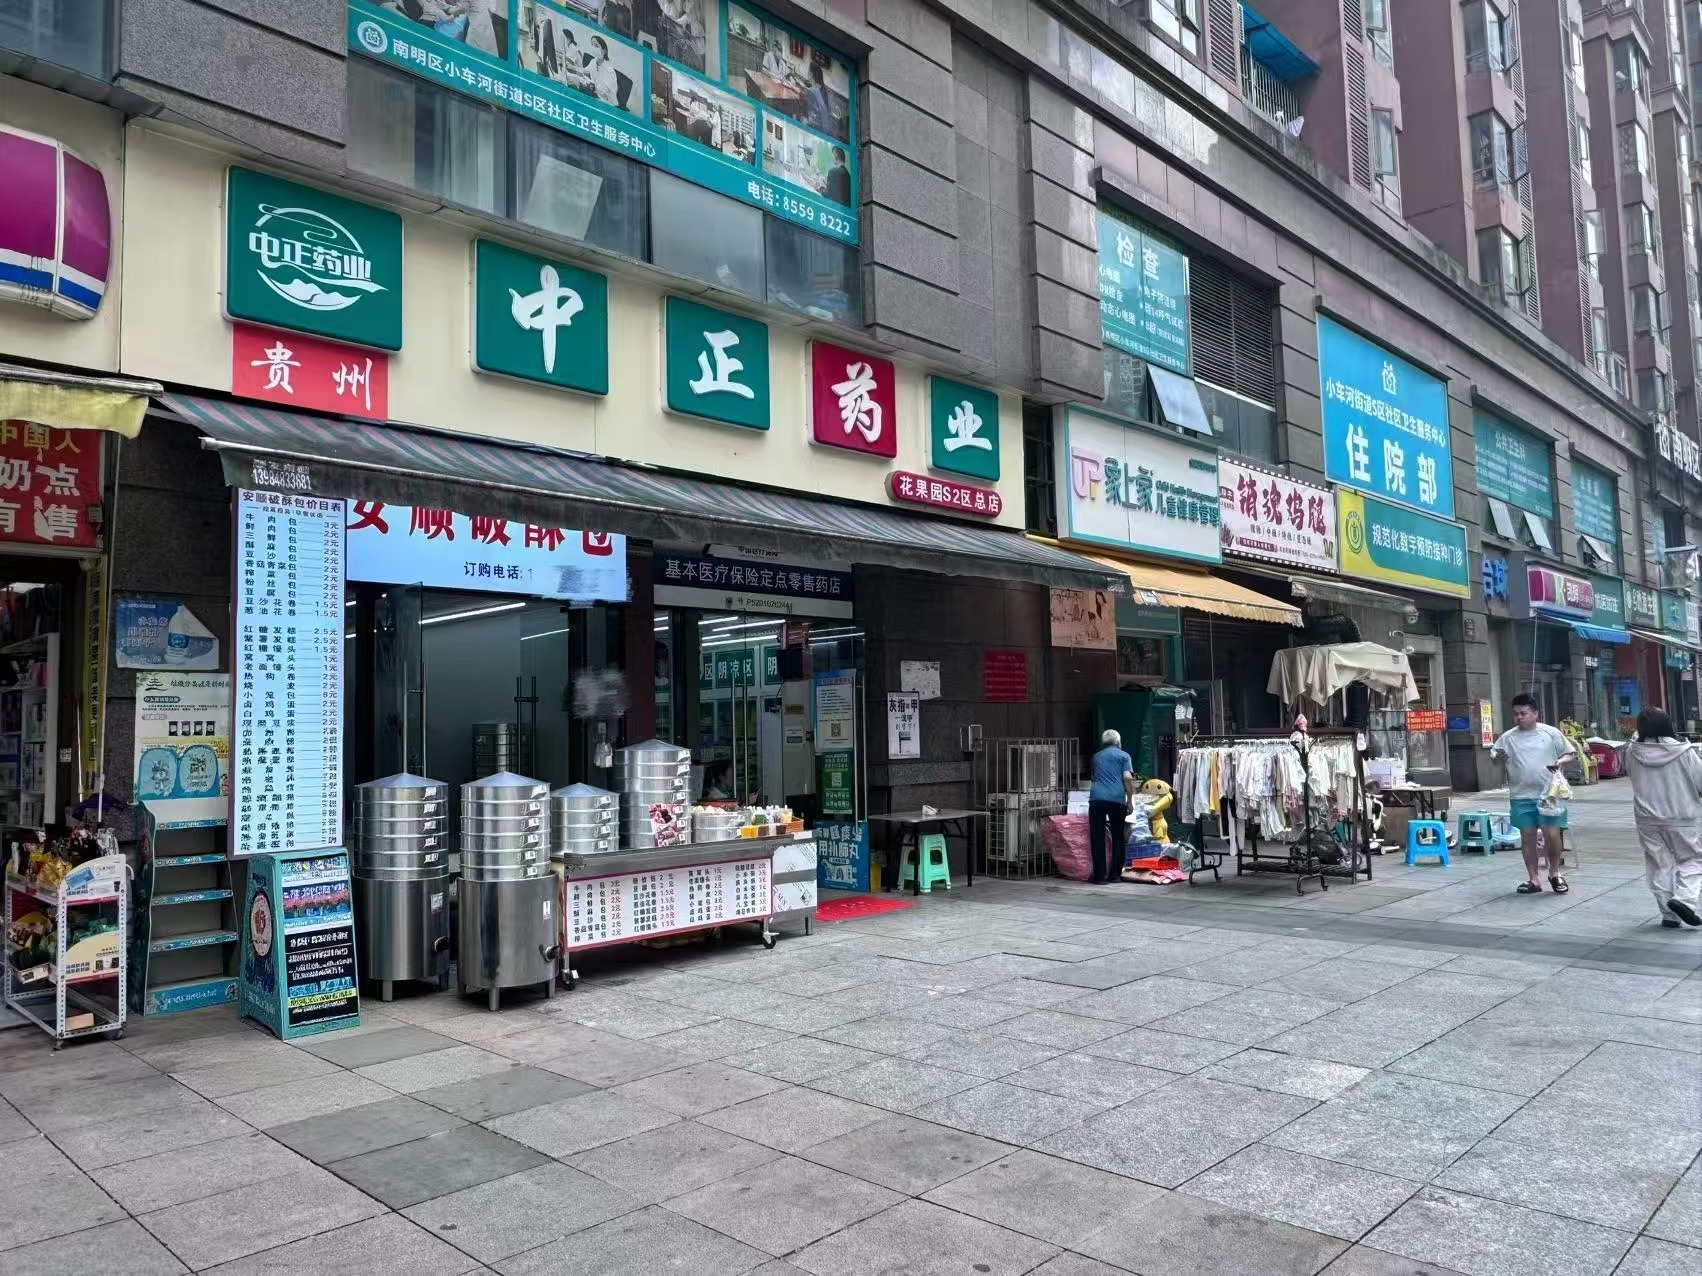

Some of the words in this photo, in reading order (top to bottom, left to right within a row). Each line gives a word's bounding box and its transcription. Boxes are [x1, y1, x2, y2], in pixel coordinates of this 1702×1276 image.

[392, 38, 656, 158] 南明区小车河街道S区社区卫生服务中心
[820, 213, 851, 236] 8222
[249, 230, 372, 282] 中正药业
[1116, 231, 1159, 281] 检查
[251, 340, 374, 411] 贵州
[508, 263, 994, 455] 中正药业
[1326, 376, 1446, 448] 小车河街道S区社区卫生服务中心
[1345, 423, 1438, 505] 住院部
[899, 474, 1001, 513] 花果园S2区总店
[1237, 472, 1326, 536] 销魂鸡腿
[245, 514, 296, 526] 牛肉包
[245, 551, 296, 562] 豆沙包
[1372, 524, 1463, 567] 规范化数字预防接种门诊
[665, 558, 841, 595] 基本医疗保险定点零售药店
[245, 598, 296, 608] 豆沙花卷
[314, 628, 338, 636] 2.5元
[244, 654, 295, 662] 窝窝头
[718, 658, 753, 680] 阴凉区
